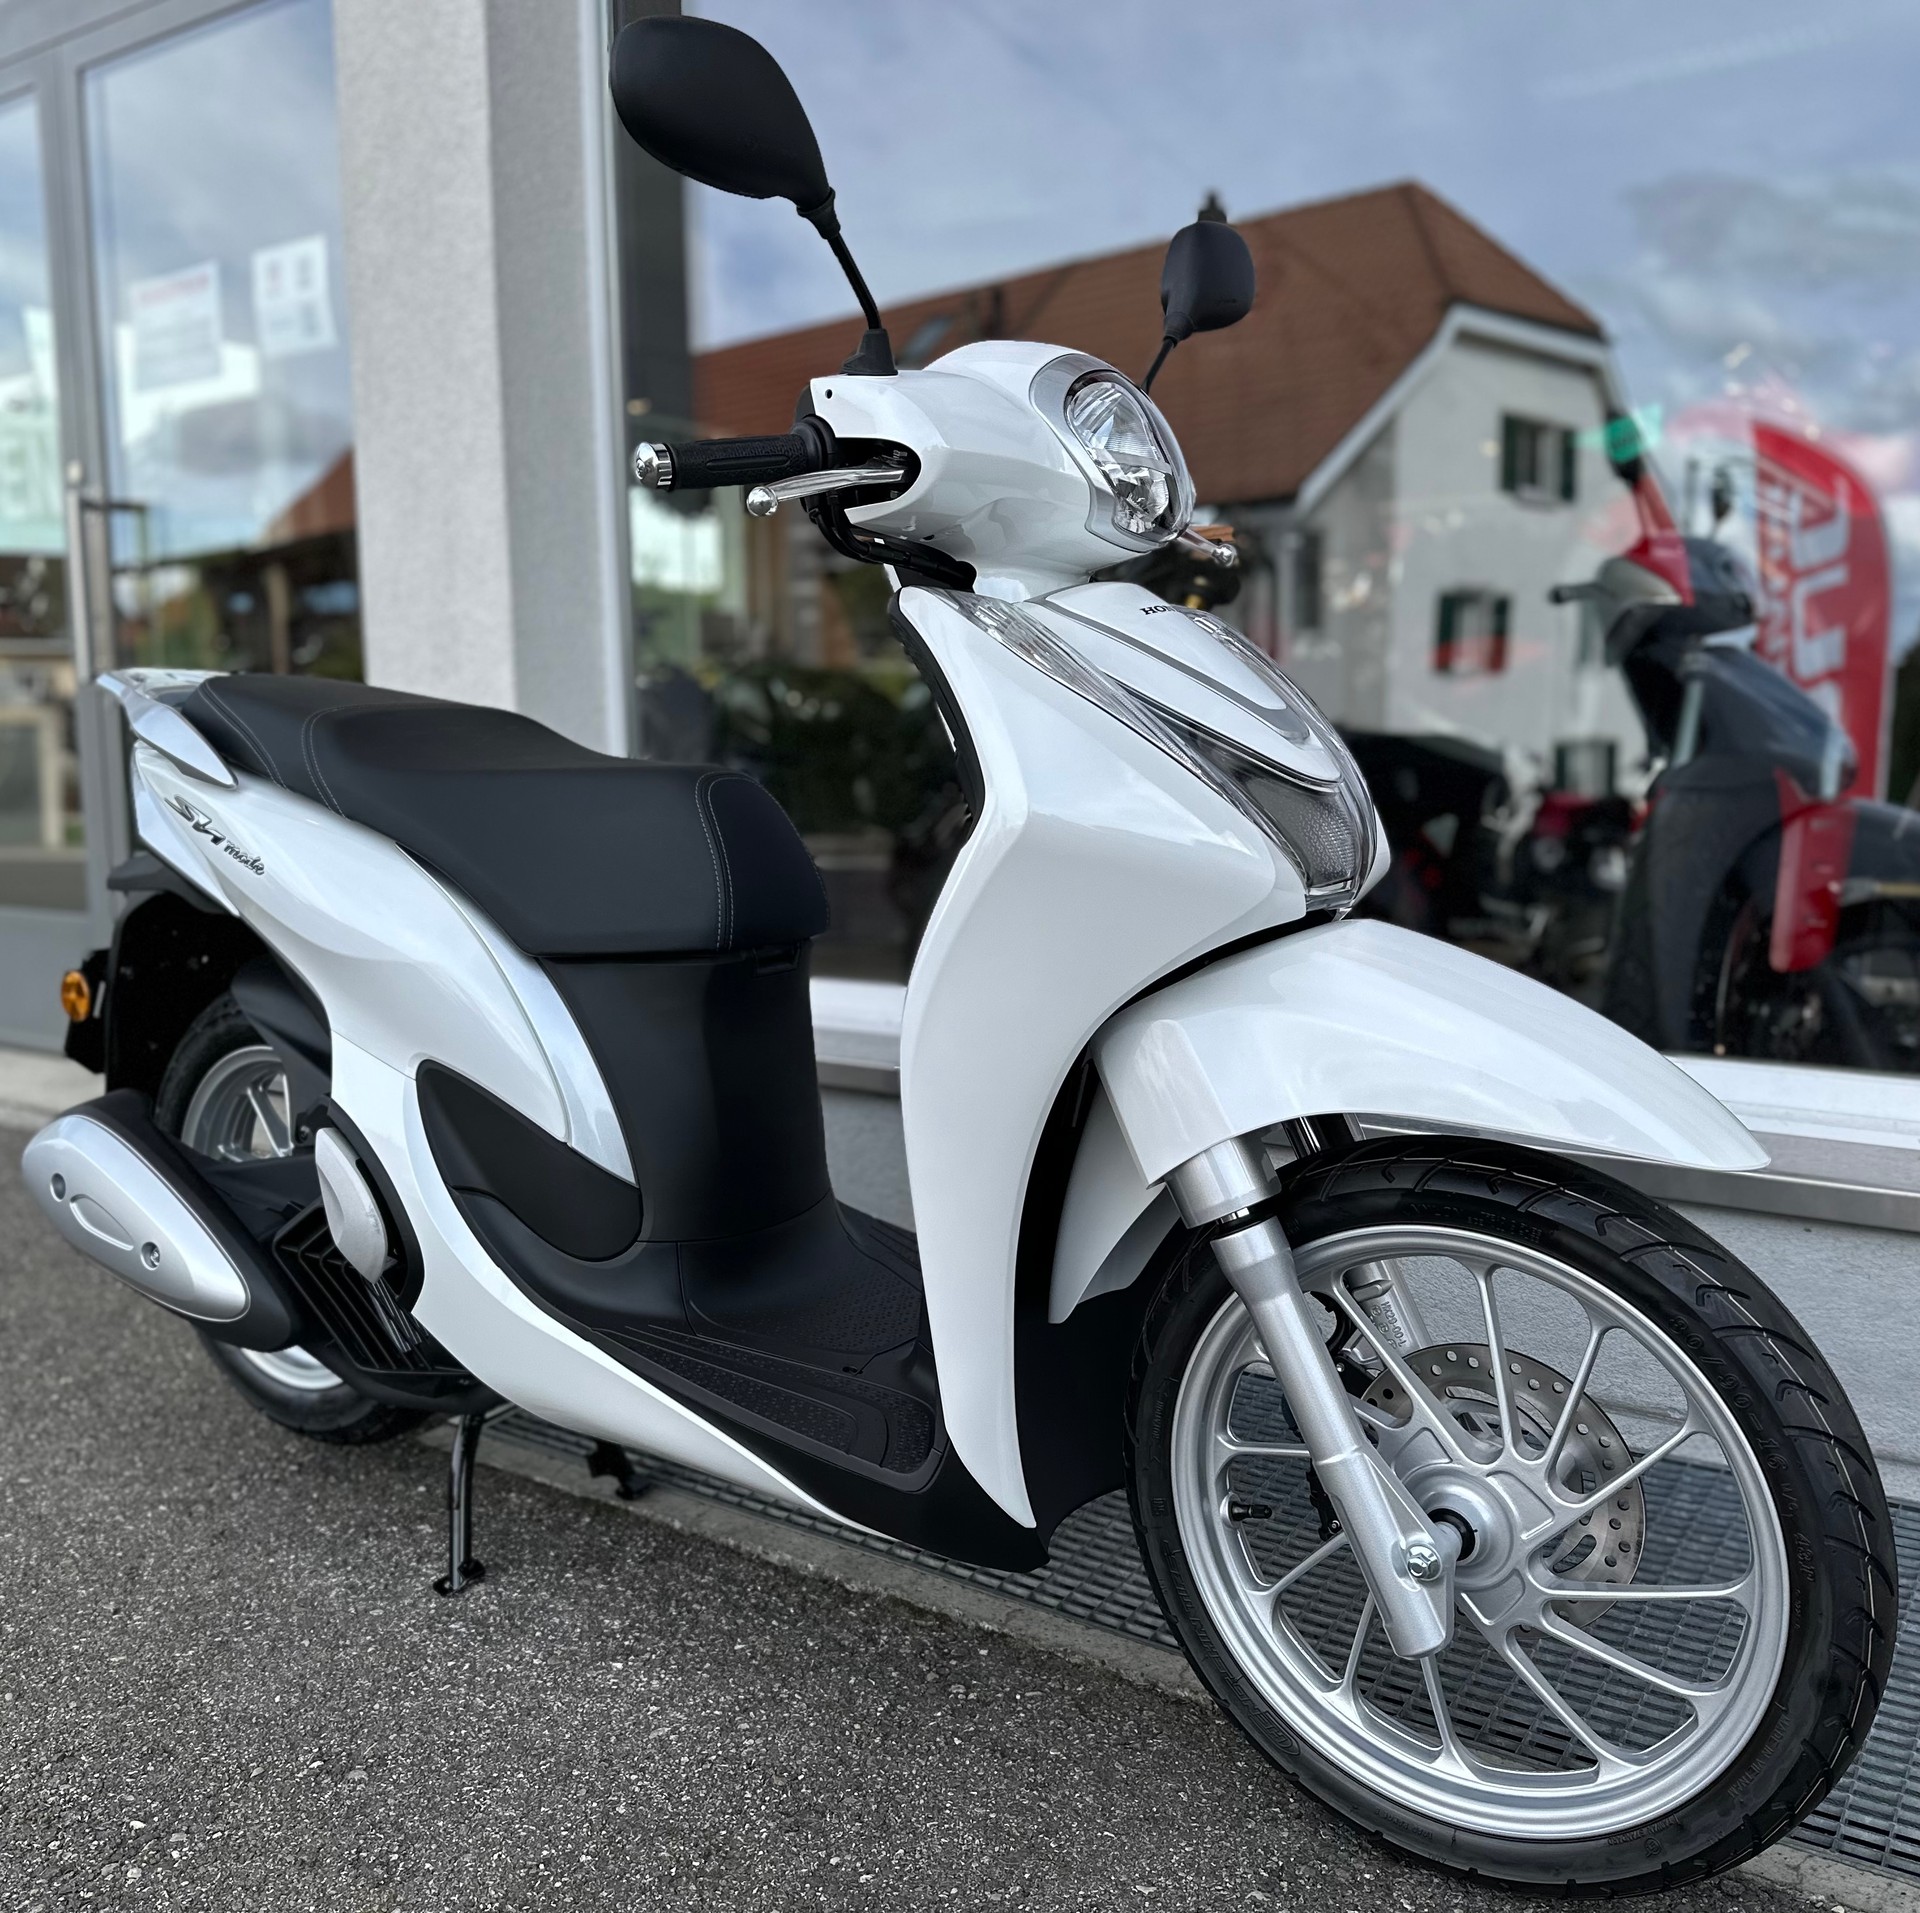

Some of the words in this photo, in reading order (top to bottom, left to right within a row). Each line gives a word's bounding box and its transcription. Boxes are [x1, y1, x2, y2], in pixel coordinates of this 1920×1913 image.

[1770, 1712, 1793, 1747] MADE
[1760, 1743, 1776, 1759] IN
[1726, 1756, 1768, 1799] VIETNAM
